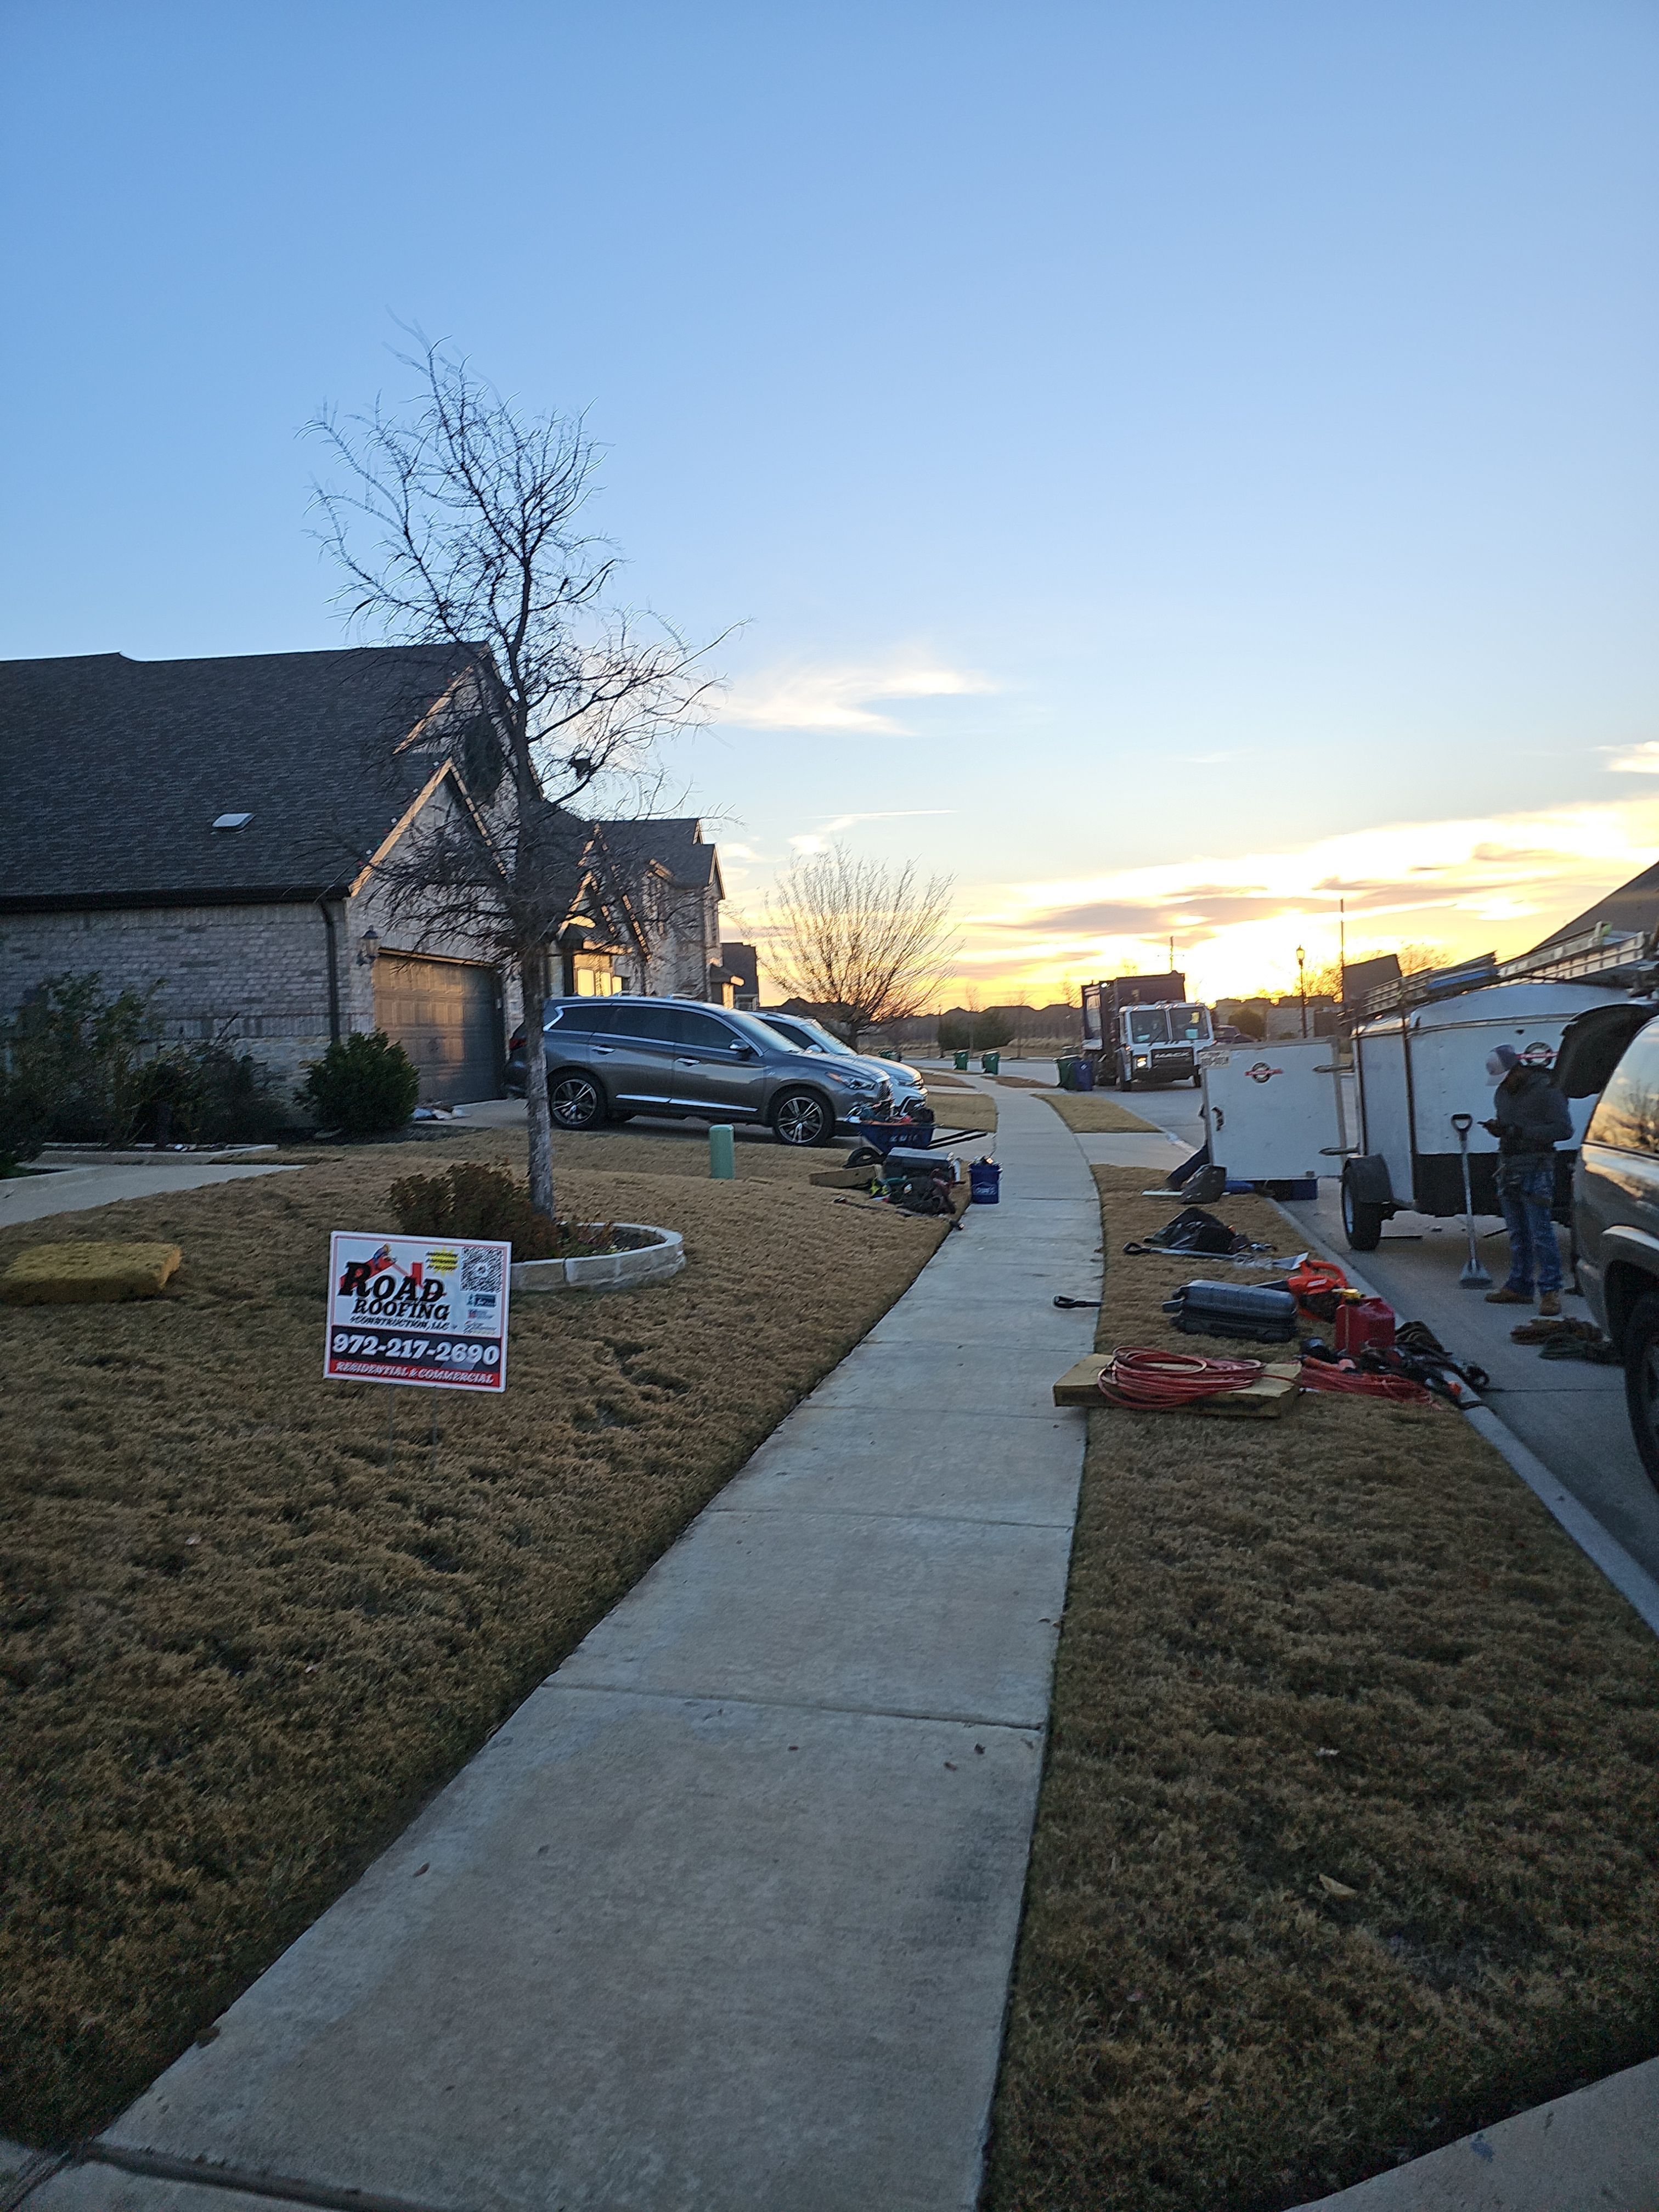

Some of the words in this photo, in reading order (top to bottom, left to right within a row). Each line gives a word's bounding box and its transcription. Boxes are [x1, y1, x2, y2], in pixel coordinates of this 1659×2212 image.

[337, 1261, 444, 1302] ROAD
[352, 1298, 450, 1319] ROOFING
[332, 1333, 500, 1365] 972-217-2690
[335, 1362, 409, 1376] RESIDENTIAL
[417, 1370, 494, 1384] COMMERCIAL
